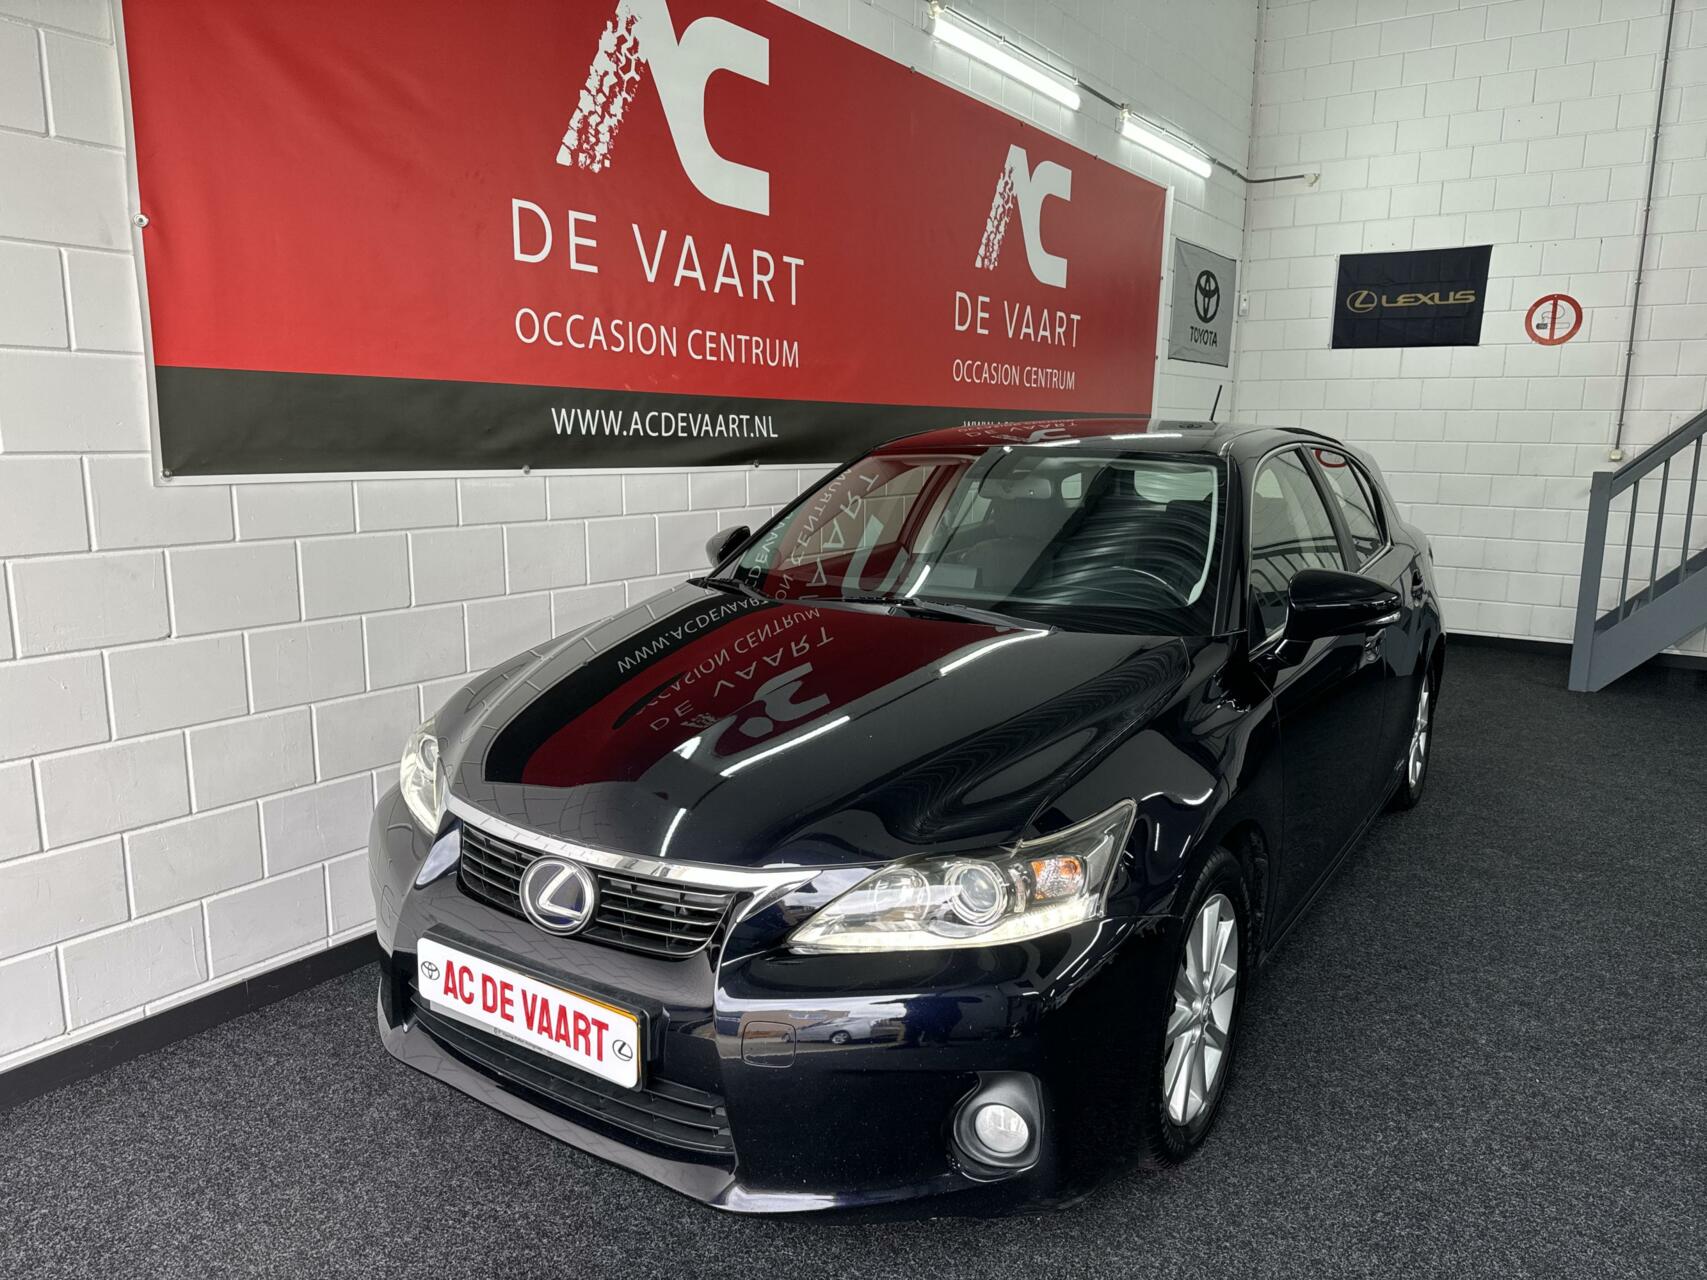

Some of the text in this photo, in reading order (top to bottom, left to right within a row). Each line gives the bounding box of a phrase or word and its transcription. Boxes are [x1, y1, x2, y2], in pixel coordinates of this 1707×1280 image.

[556, 0, 770, 216] AC
[975, 143, 1072, 288] AC
[512, 198, 804, 305] DE VAART
[954, 291, 1081, 348] DE VAART
[1381, 290, 1475, 307] LEXUS
[515, 307, 799, 368] OCCASION CENTRUM
[1190, 326, 1217, 347] TOYOTA
[952, 359, 1075, 390] OCCASION CENTRUM
[551, 408, 778, 437] WWW.ACDEVAART.NL
[444, 960, 474, 1005] AC
[482, 973, 514, 1023] DE
[521, 989, 609, 1062] VAART
